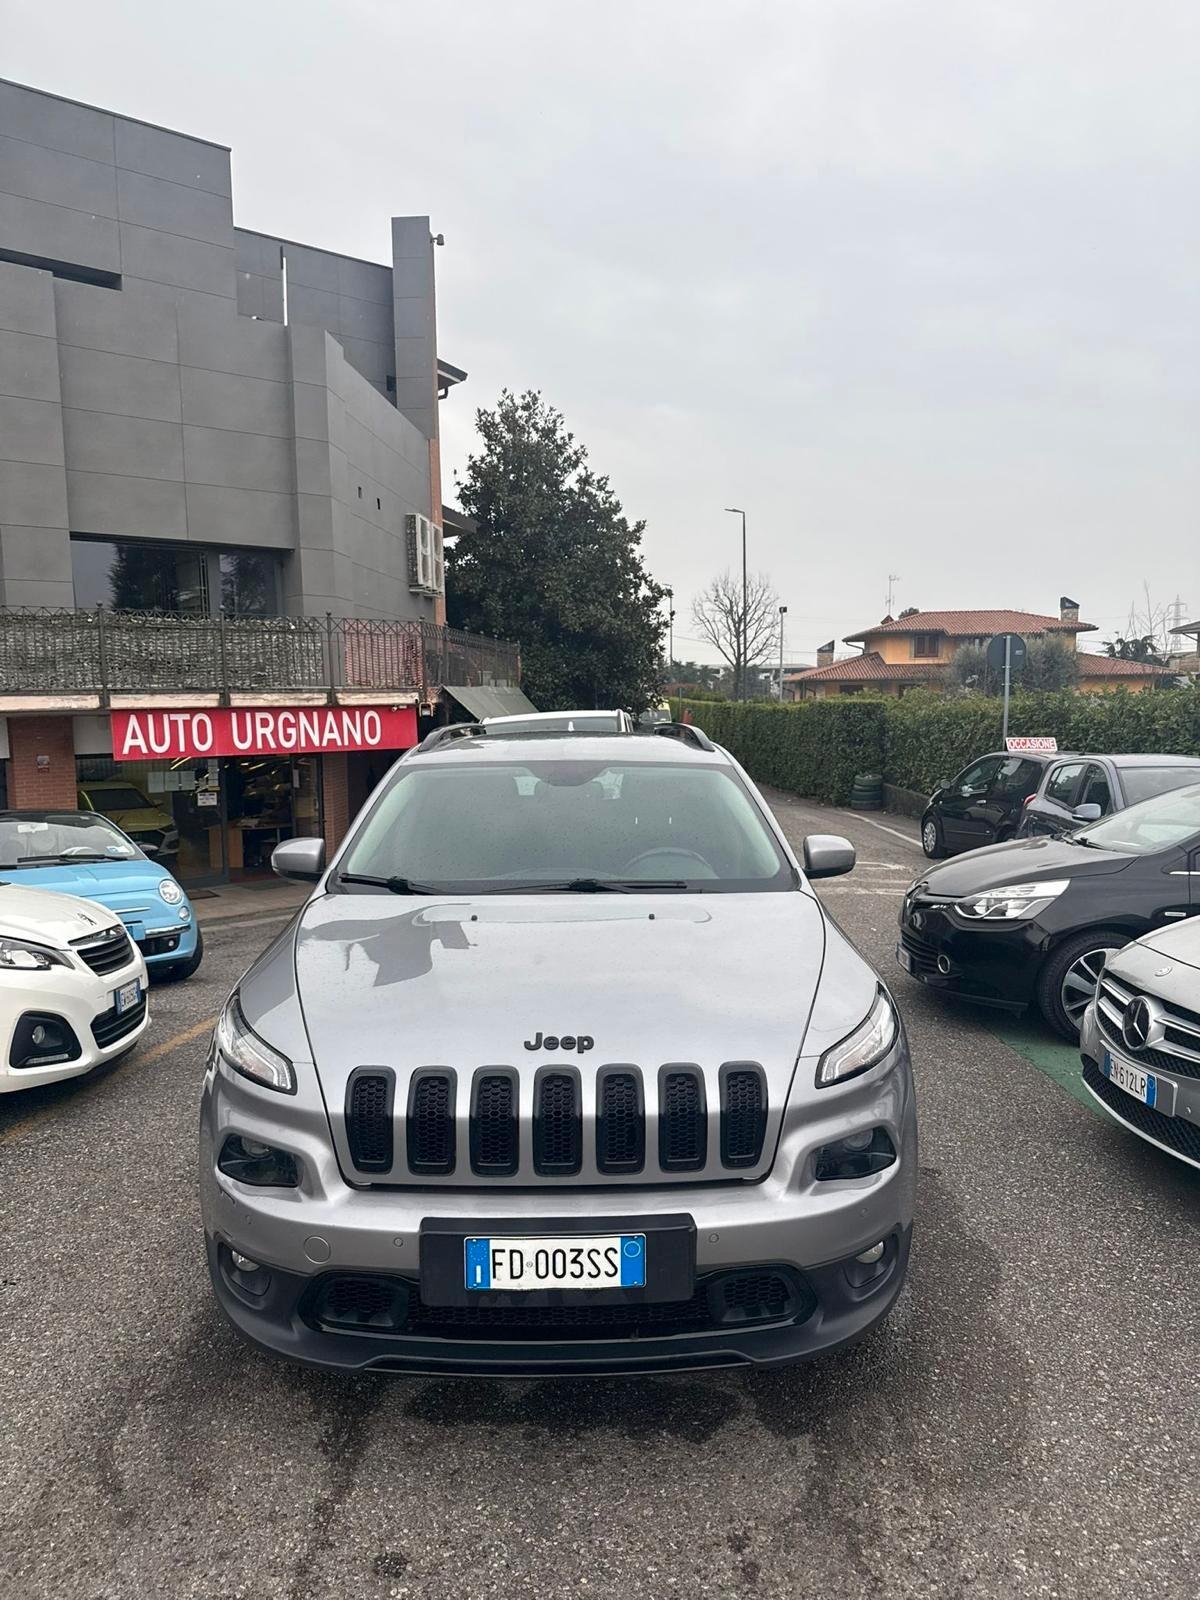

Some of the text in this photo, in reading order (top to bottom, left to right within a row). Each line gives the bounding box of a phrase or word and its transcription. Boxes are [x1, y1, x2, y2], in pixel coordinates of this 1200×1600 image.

[122, 710, 381, 755] AUTO URGNANO
[1008, 739, 1055, 749] OCCASIONE
[524, 1032, 594, 1053] Jeep
